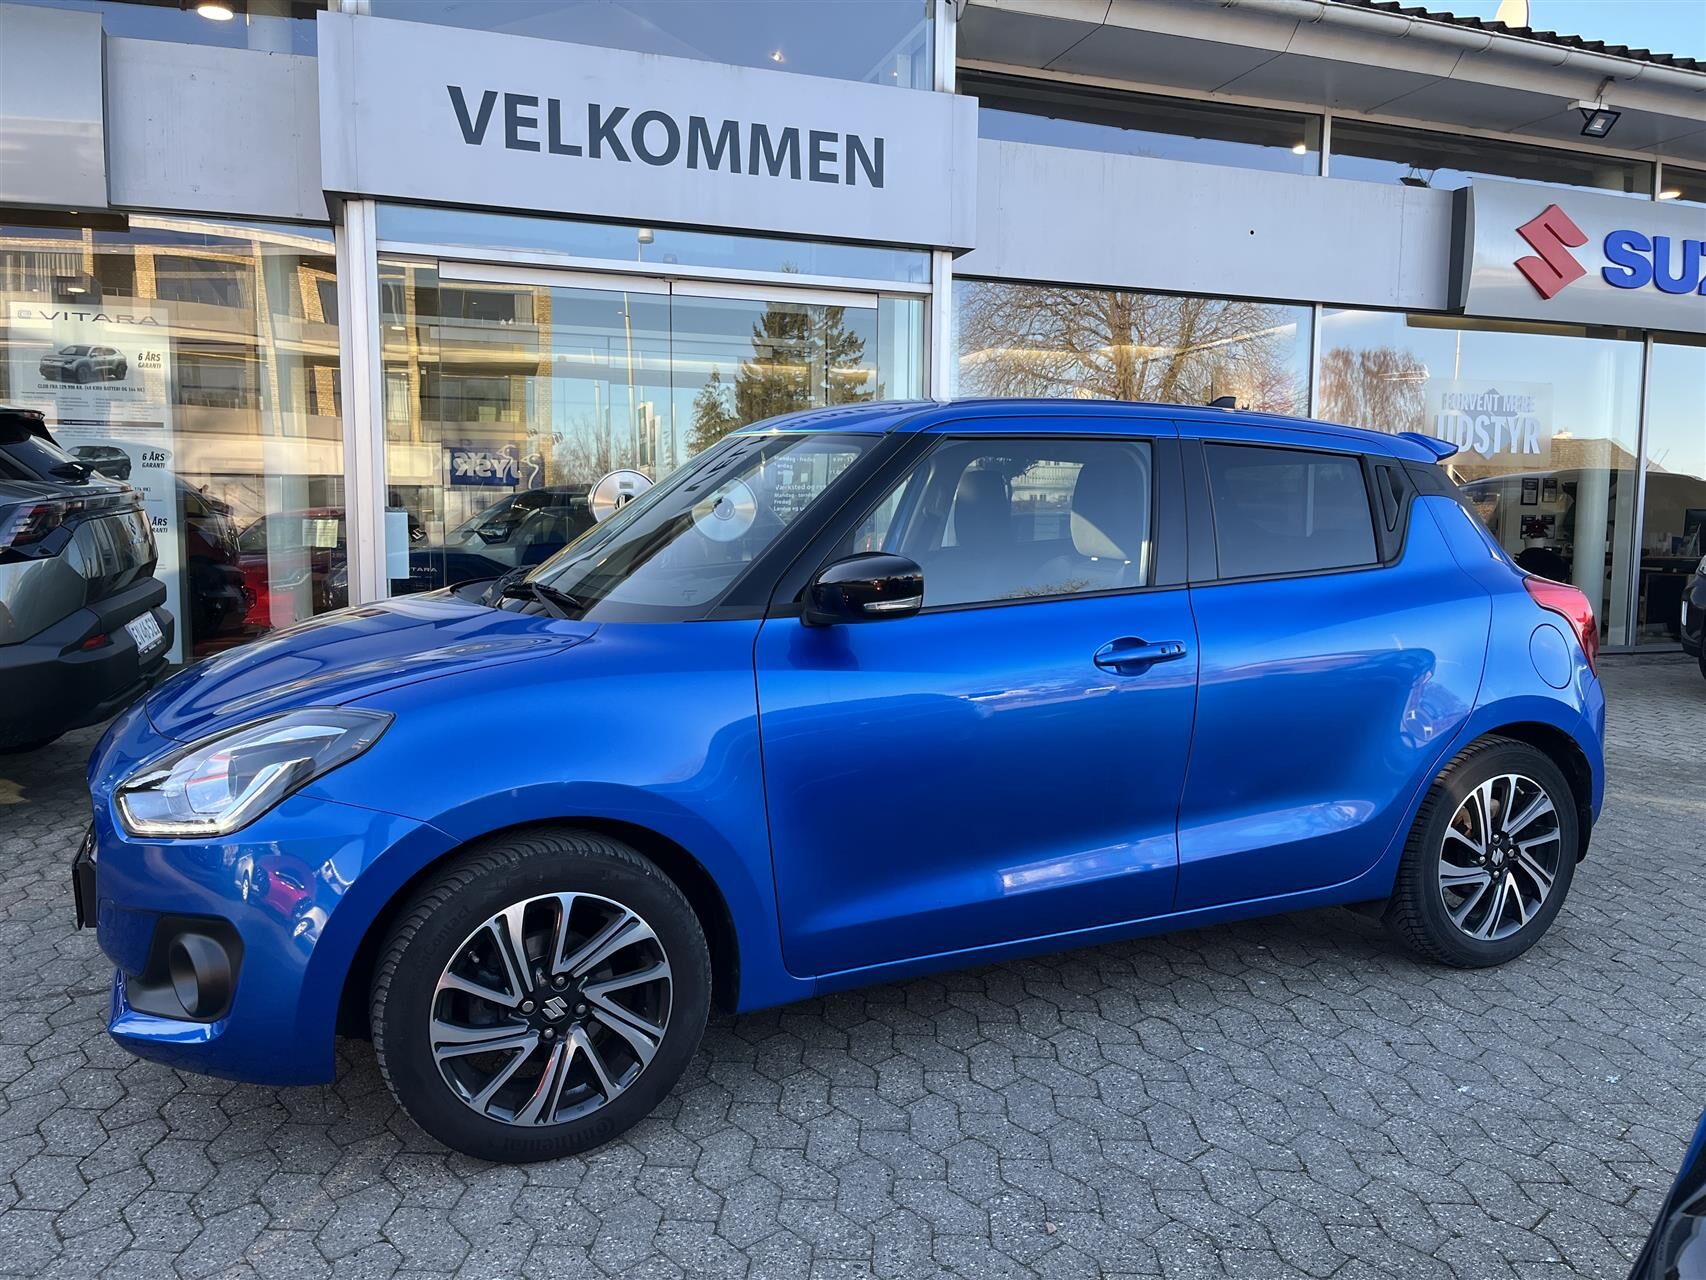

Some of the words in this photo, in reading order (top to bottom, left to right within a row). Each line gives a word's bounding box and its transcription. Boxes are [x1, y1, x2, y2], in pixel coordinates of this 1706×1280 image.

[447, 85, 885, 188] VELKOMMEN
[1601, 229, 1706, 296] SU
[40, 311, 161, 326] VITARA
[137, 353, 143, 361] 6
[145, 351, 161, 362] ÅRS
[1435, 413, 1540, 455] UDSTYR
[142, 453, 147, 461] 6
[149, 451, 165, 461] ÅRS
[152, 516, 168, 526] ÅRS
